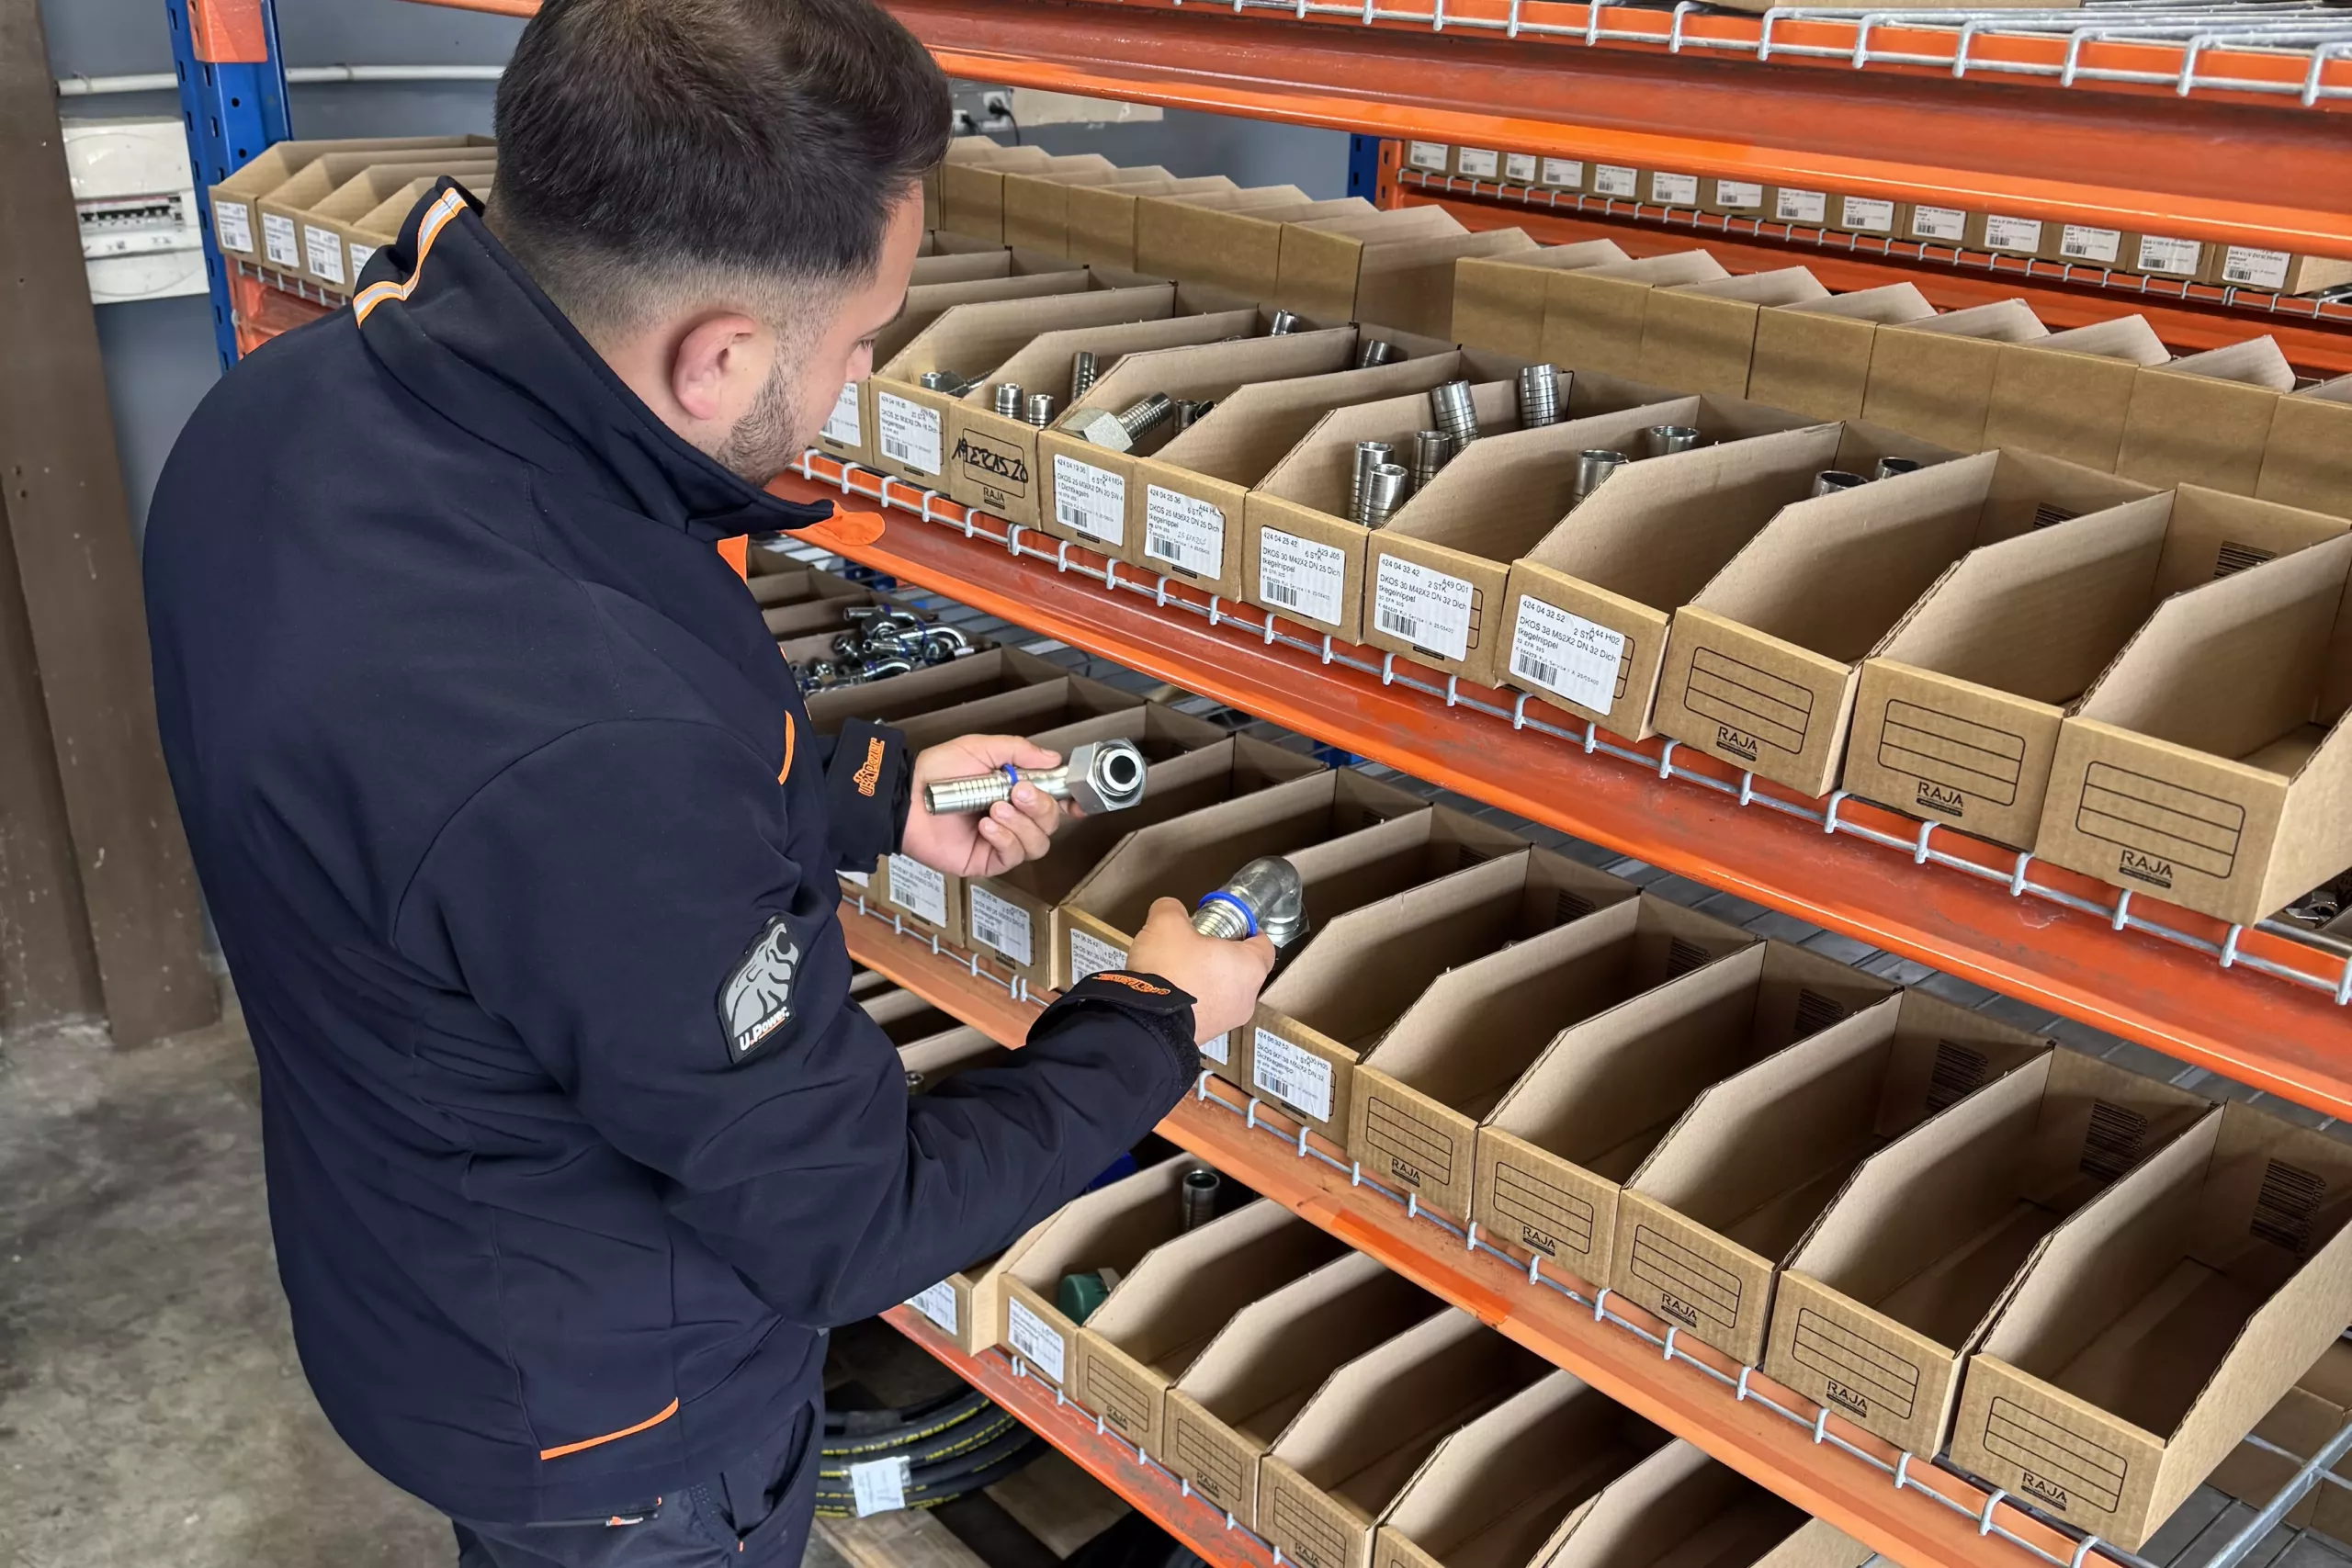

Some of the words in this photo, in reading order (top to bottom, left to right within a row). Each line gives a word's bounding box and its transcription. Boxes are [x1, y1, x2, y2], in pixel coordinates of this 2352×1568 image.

[983, 487, 1004, 502] RAJA
[1208, 523, 1219, 533] Dich
[1263, 532, 1273, 540] 424
[1262, 558, 1295, 573] tkegelnippel
[1263, 547, 1279, 558] DKOS
[1308, 560, 1318, 570] DN
[1328, 567, 1340, 577] Dich
[1310, 552, 1322, 561] STK
[1381, 558, 1393, 568] 424
[1394, 562, 1401, 570] 04
[1378, 584, 1416, 603] tkegelnippel
[1380, 574, 1399, 586] DKOS
[1400, 581, 1408, 590] 30
[1408, 584, 1430, 598] M42X2
[1431, 592, 1442, 602] DN
[1443, 596, 1451, 604] 32
[1453, 600, 1466, 610] Dich
[1433, 582, 1447, 592] STK
[1522, 600, 1534, 611] 424
[1536, 604, 1545, 614] 04
[1546, 609, 1555, 618] 32
[1556, 613, 1566, 623] 52
[1518, 627, 1559, 649] tkegelnippel
[1520, 616, 1541, 631] DKOS
[1543, 626, 1551, 636] 38
[1552, 629, 1575, 646] M52X2
[1577, 639, 1589, 651] DN
[1589, 645, 1599, 655] 32
[1600, 649, 1616, 663] Dich
[1580, 631, 1594, 643] STK
[1589, 627, 1603, 638] A44
[1605, 632, 1620, 645] H02
[1718, 726, 1758, 753] RAJA
[1917, 781, 1963, 807] RAJA
[2120, 850, 2173, 879] RAJA
[1392, 1157, 1419, 1181] RAJA
[1522, 1225, 1555, 1250] RAJA
[1662, 1292, 1697, 1321] RAJA
[1827, 1381, 1867, 1411] RAJA
[1106, 1405, 1128, 1425] RAJA
[1197, 1472, 1219, 1493] RAJA
[2022, 1472, 2067, 1504] RAJA
[1295, 1542, 1319, 1566] RAJA
